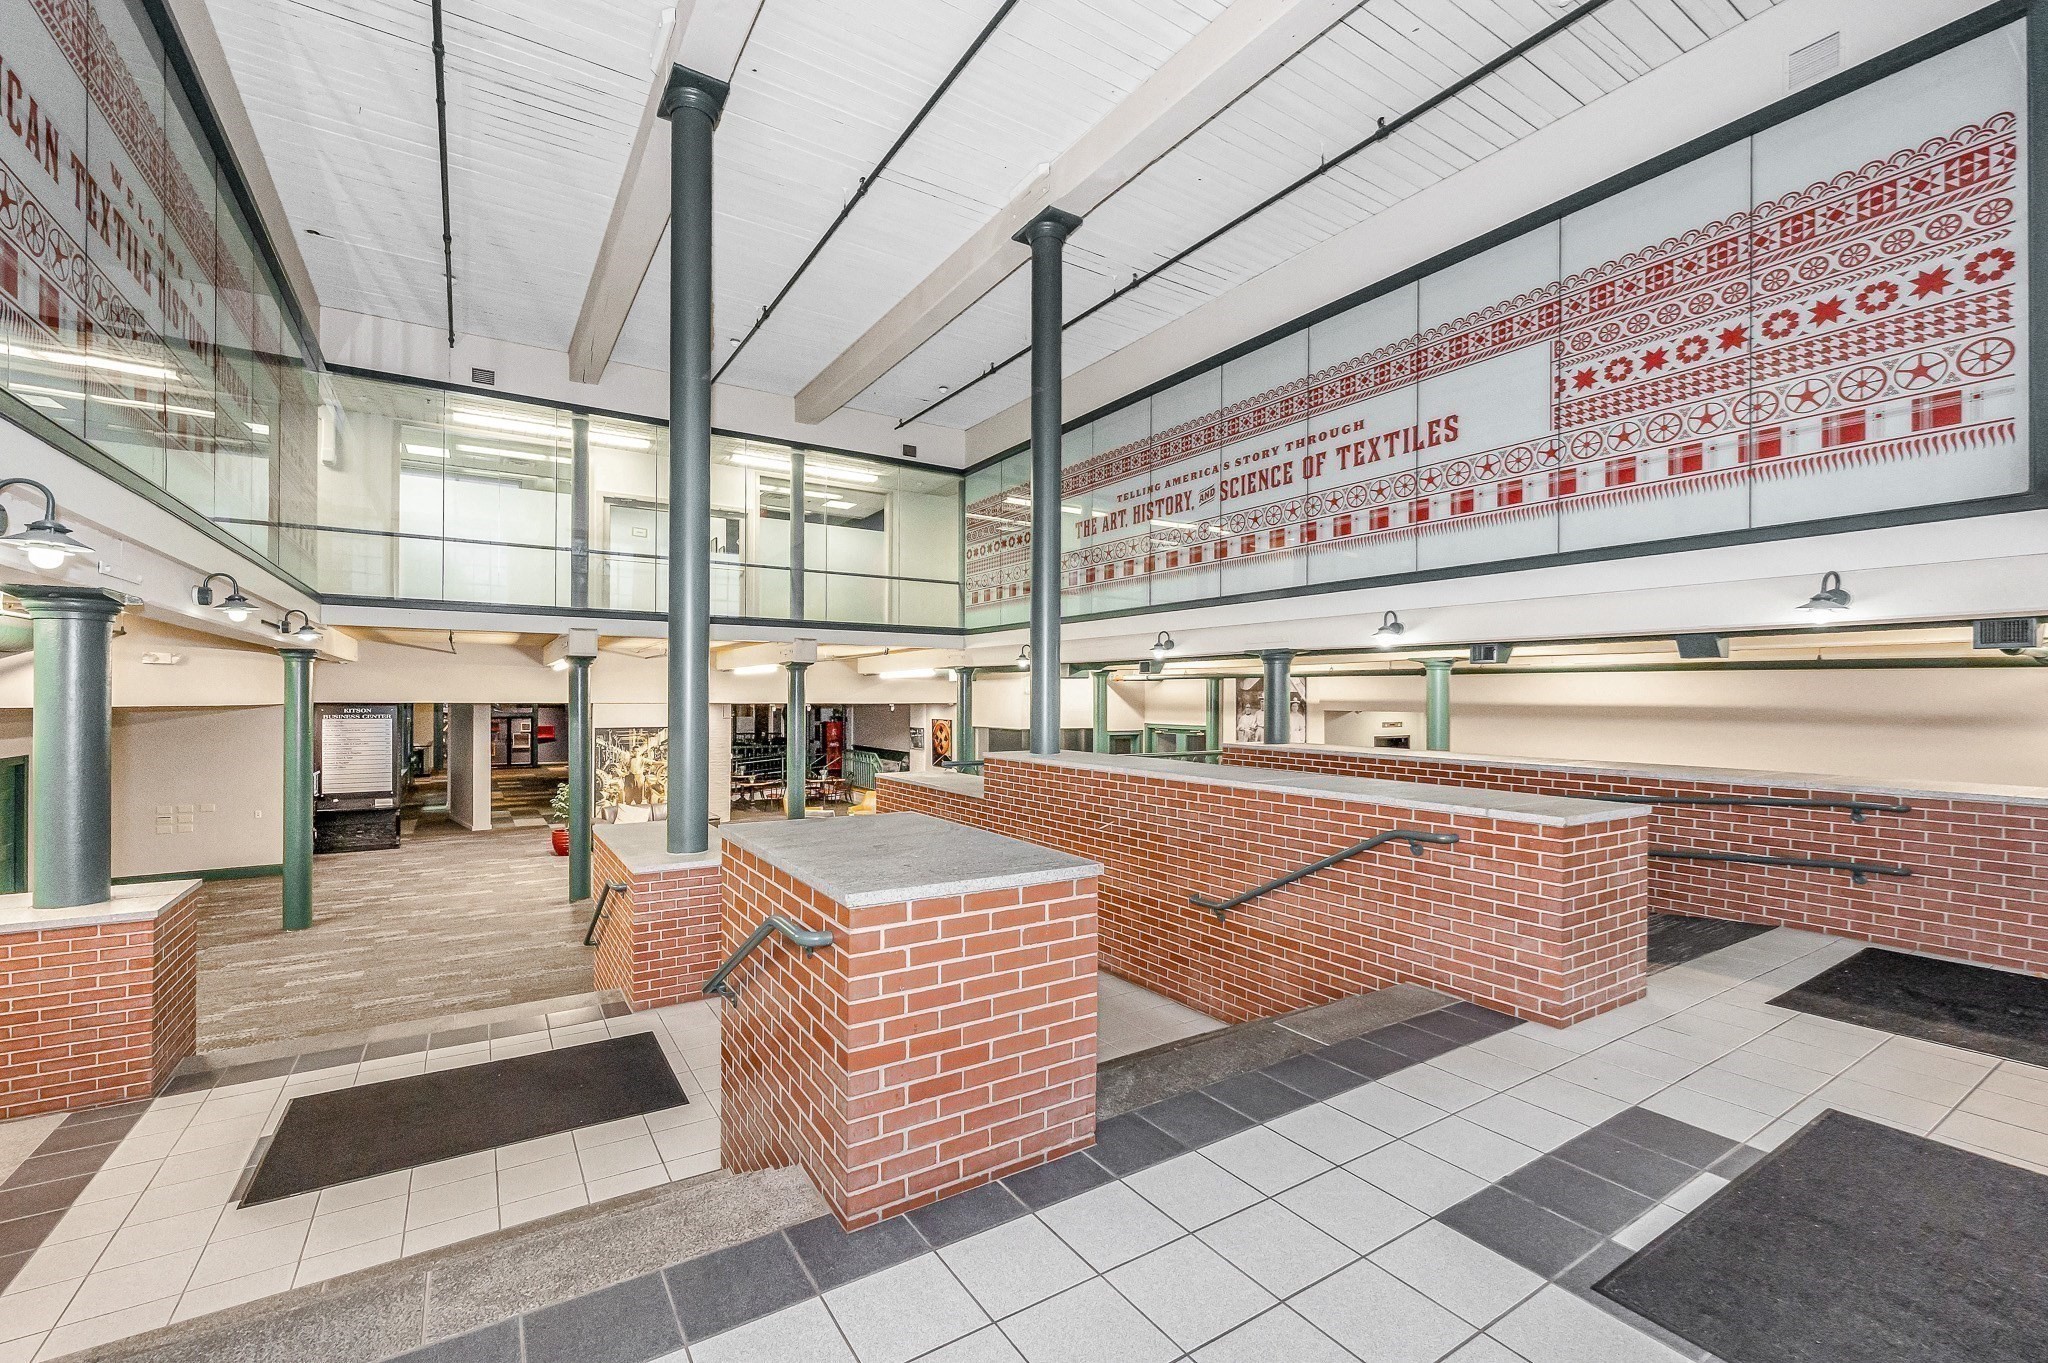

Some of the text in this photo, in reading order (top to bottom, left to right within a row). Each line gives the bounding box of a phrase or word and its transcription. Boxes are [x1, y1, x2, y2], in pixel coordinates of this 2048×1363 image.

[69, 149, 151, 298] TEXTILE
[158, 267, 209, 366] HISTORY
[110, 160, 203, 308] WELCOME TO
[1075, 517, 1097, 539] THE
[1198, 486, 1216, 503] AND
[1219, 461, 1293, 501] SCIENCE
[1302, 451, 1327, 480] OF
[1336, 414, 1459, 470] TEXTILES
[1117, 483, 1161, 502] TELLING
[1234, 445, 1279, 467] STORY
[1285, 418, 1365, 452] THROUGH
